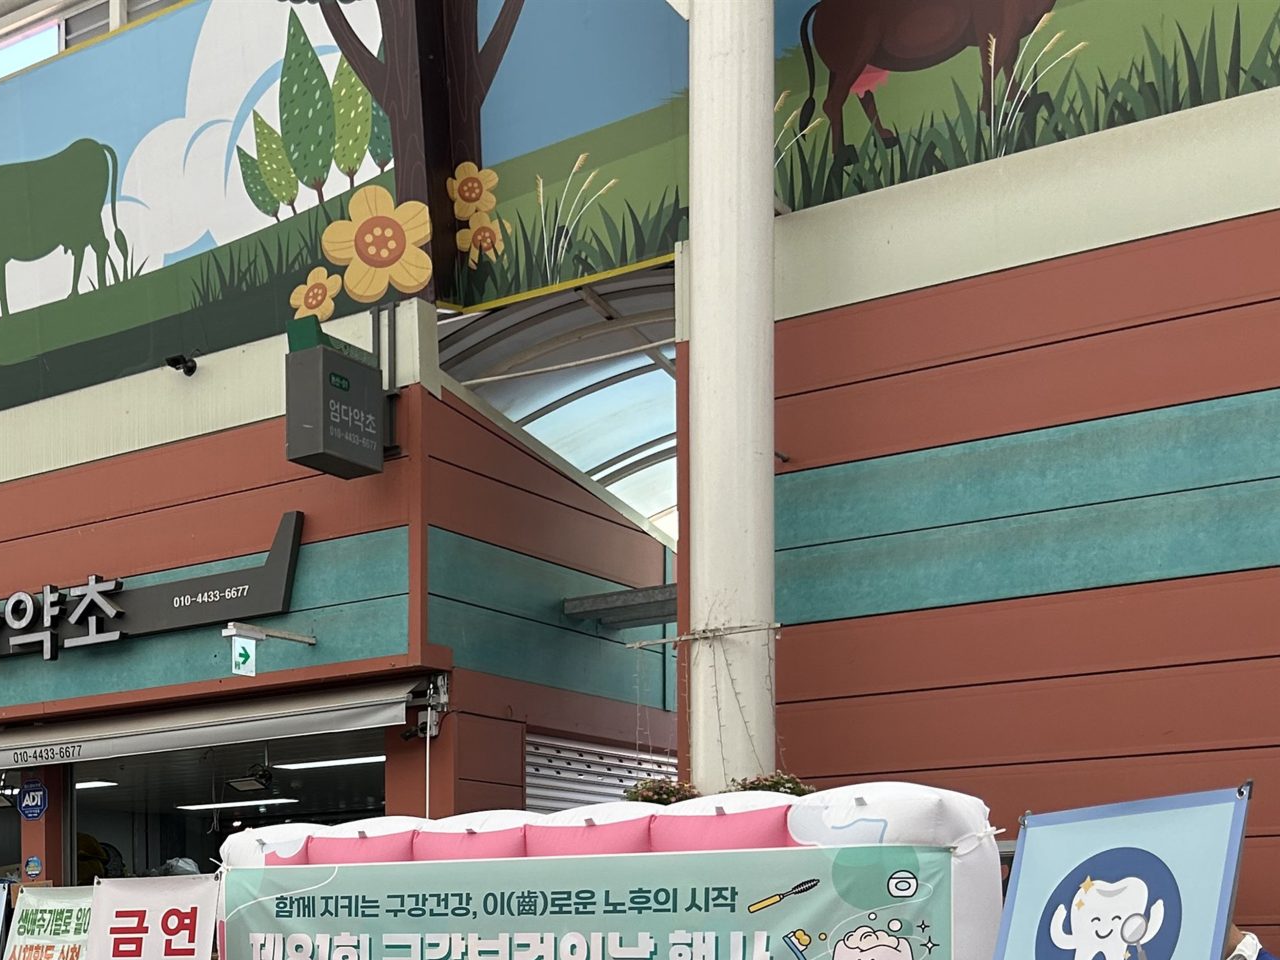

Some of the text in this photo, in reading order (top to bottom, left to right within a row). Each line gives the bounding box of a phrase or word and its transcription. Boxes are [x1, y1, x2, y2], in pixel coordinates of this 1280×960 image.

[329, 400, 376, 433] 염다약초
[173, 585, 250, 608] 010-4433-6677
[13, 745, 82, 763] 010-4433-6677
[22, 791, 43, 807] ADT
[275, 886, 739, 919] 함께 지키는 구강건강, 이(齒)로운 노후의 시작
[17, 908, 73, 936] 생애주기별로
[109, 906, 198, 958] 금연
